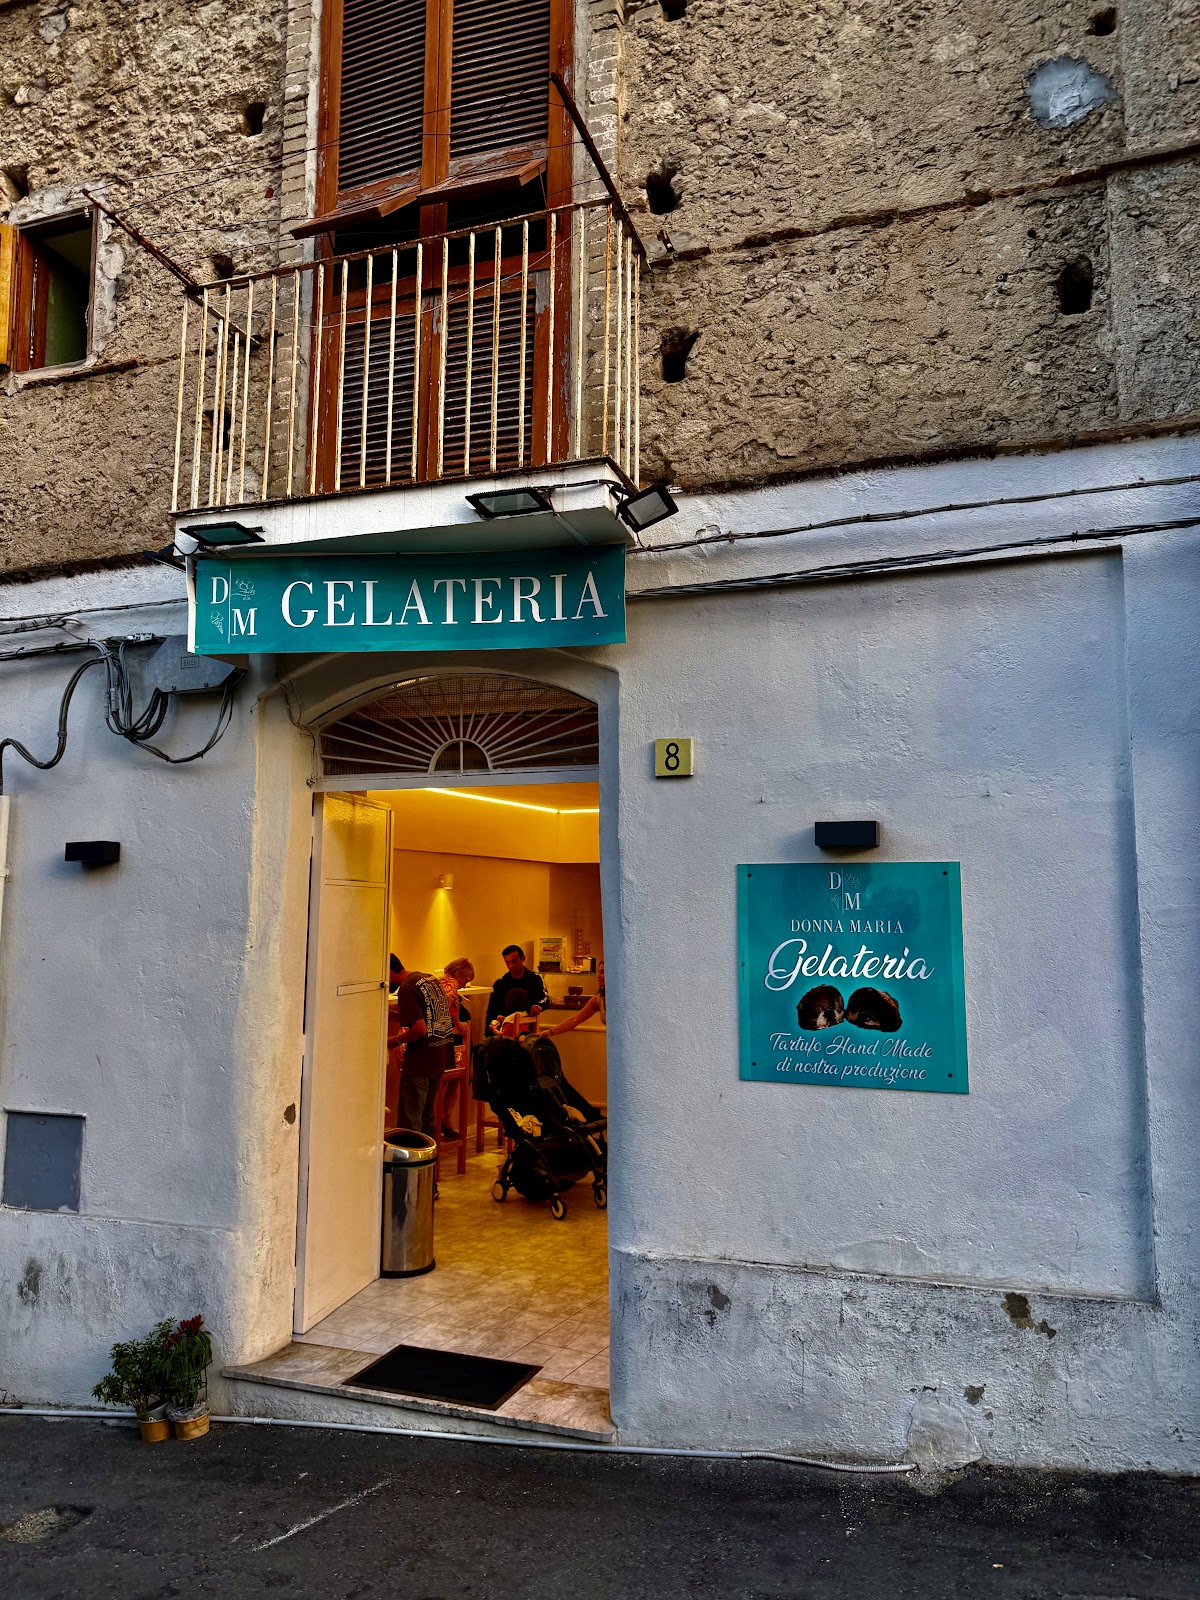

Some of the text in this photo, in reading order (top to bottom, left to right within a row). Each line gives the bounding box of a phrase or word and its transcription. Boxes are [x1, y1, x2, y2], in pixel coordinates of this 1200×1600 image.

[210, 576, 229, 605] D
[281, 570, 609, 629] GELATERIA
[231, 607, 258, 637] M
[664, 742, 680, 771] 8
[828, 871, 842, 890] D
[843, 892, 862, 911] M
[790, 919, 905, 934] DONNA MARIA
[764, 938, 935, 991] Gelateria
[769, 1032, 934, 1059] Tartufo Hand Made
[776, 1056, 928, 1085] di nostra produzione
